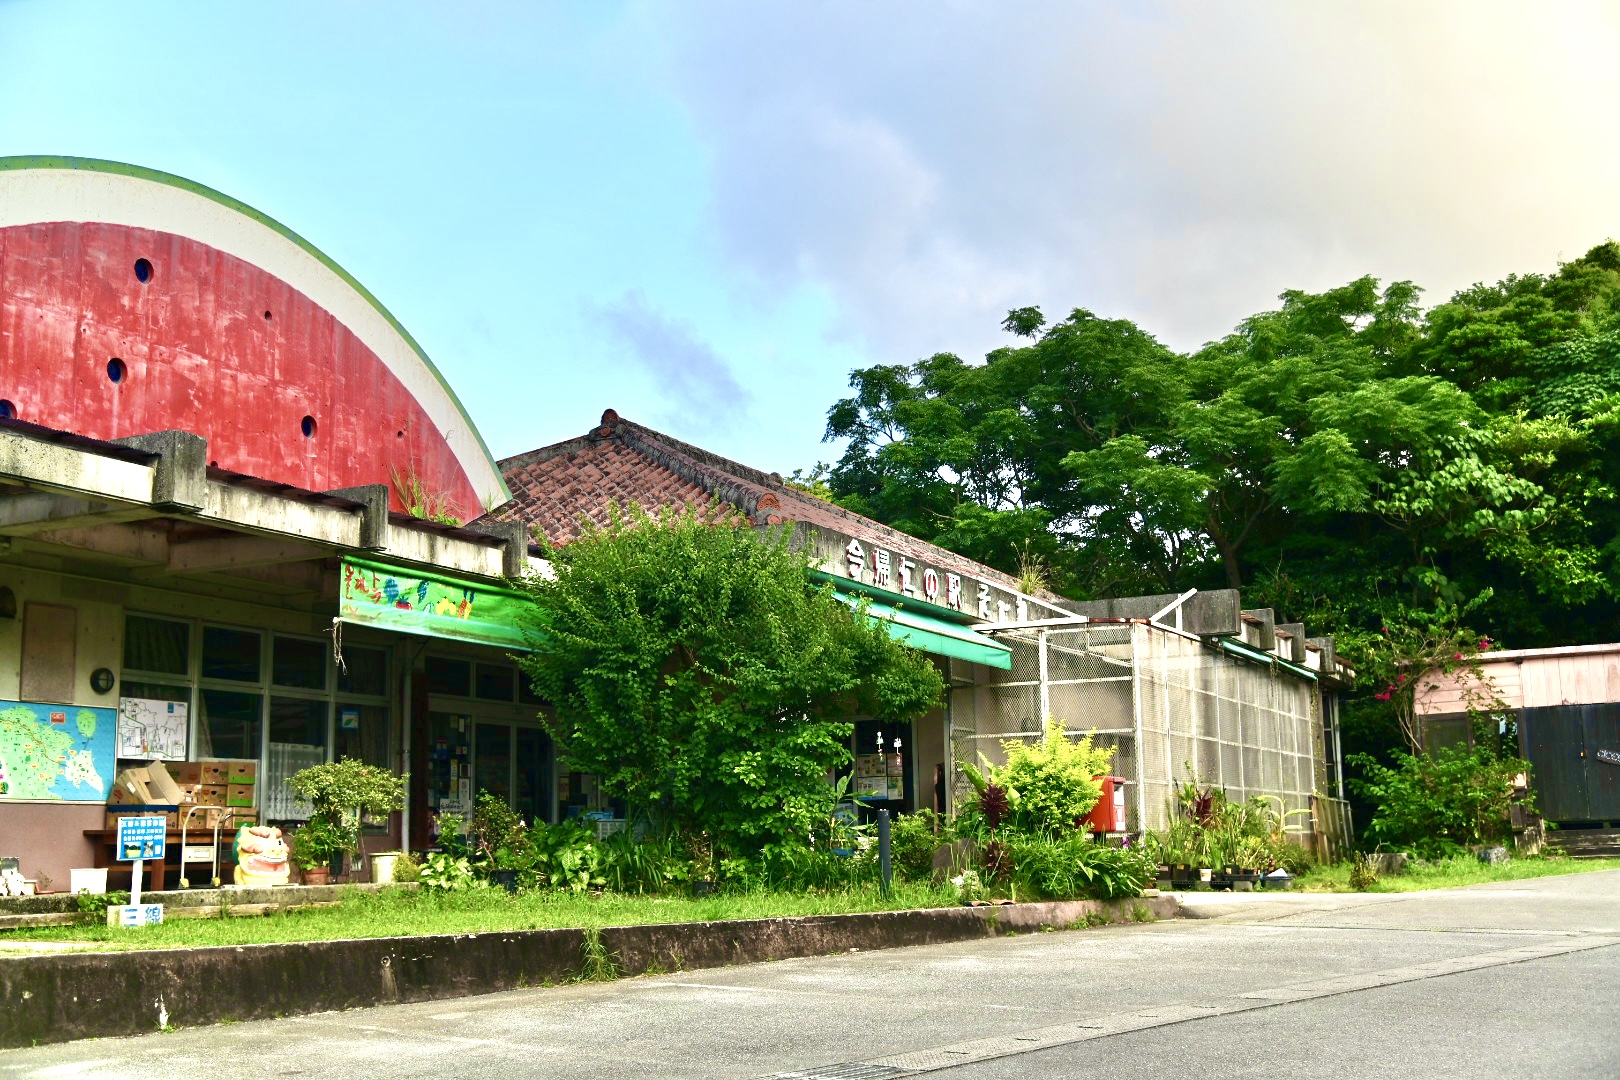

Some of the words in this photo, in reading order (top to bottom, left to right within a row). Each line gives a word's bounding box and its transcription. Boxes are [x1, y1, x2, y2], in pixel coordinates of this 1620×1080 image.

[846, 538, 963, 611] 今帰仁の駅
[124, 906, 161, 927] 三線
